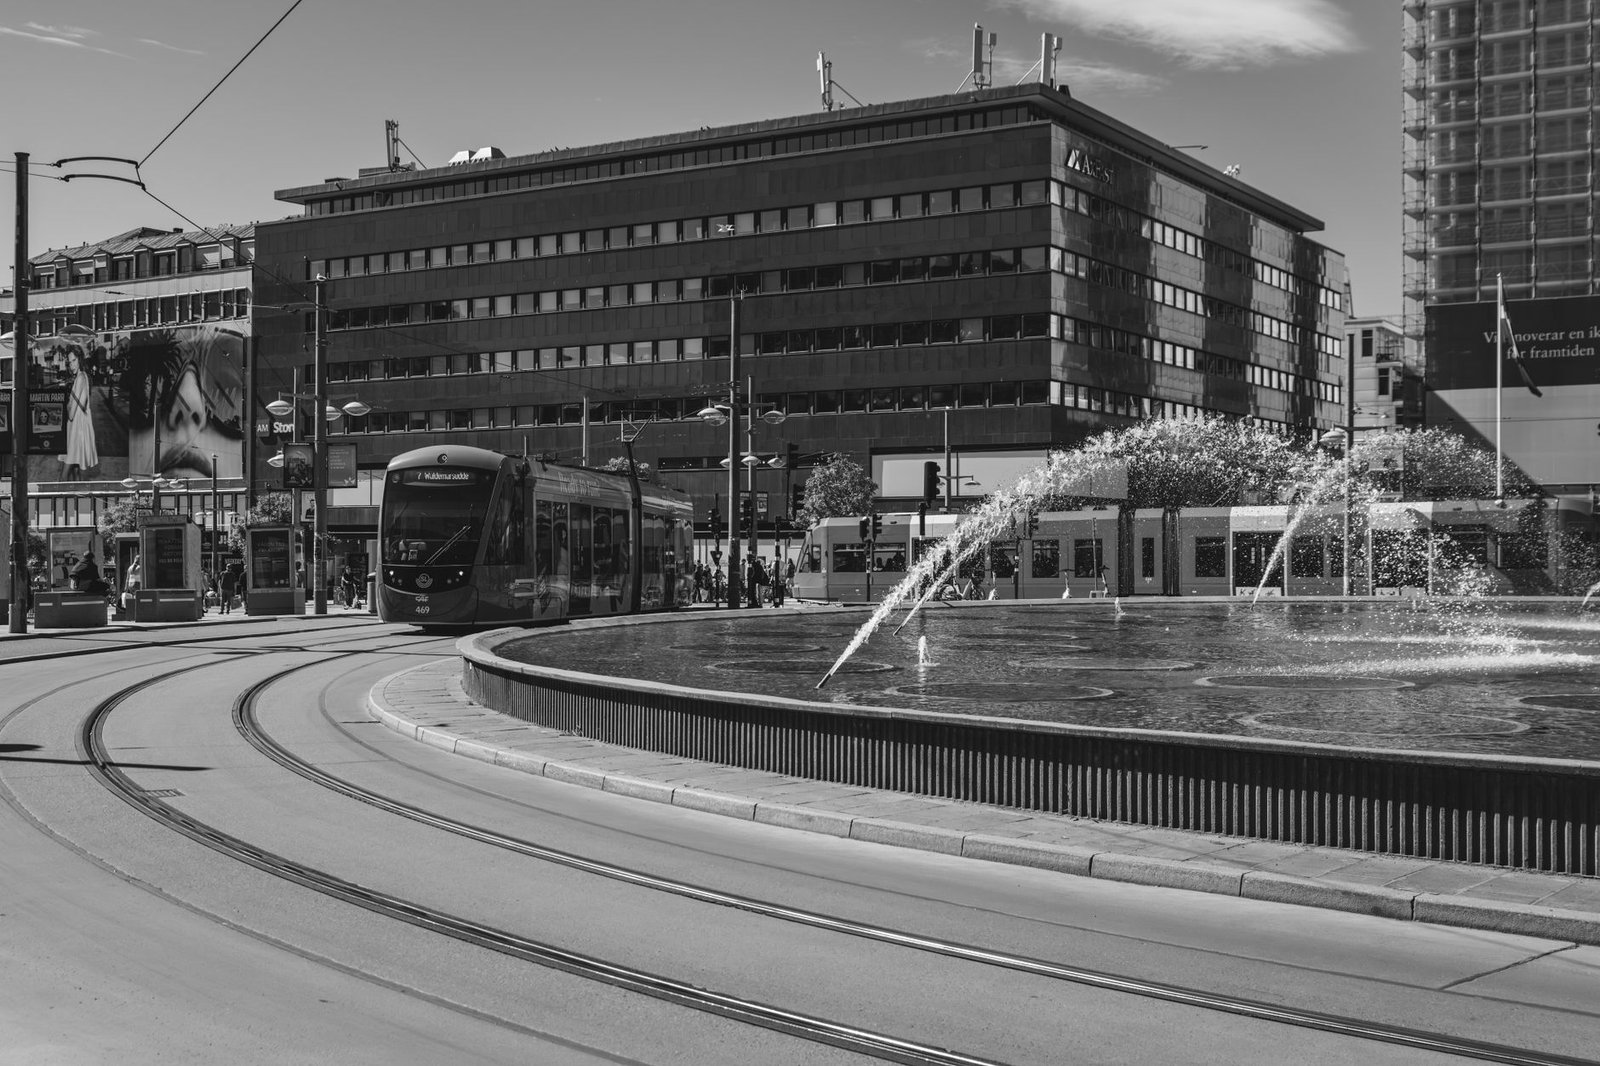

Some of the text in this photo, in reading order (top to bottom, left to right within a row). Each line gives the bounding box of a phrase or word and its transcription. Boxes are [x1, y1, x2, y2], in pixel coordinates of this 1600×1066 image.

[1503, 331, 1566, 344] noverar
[1569, 330, 1584, 341] en
[1530, 344, 1595, 359] framtiden
[29, 392, 65, 402] MARTIN PARR
[273, 421, 295, 434] Stor
[417, 472, 422, 480] 7
[415, 605, 430, 614] 469
